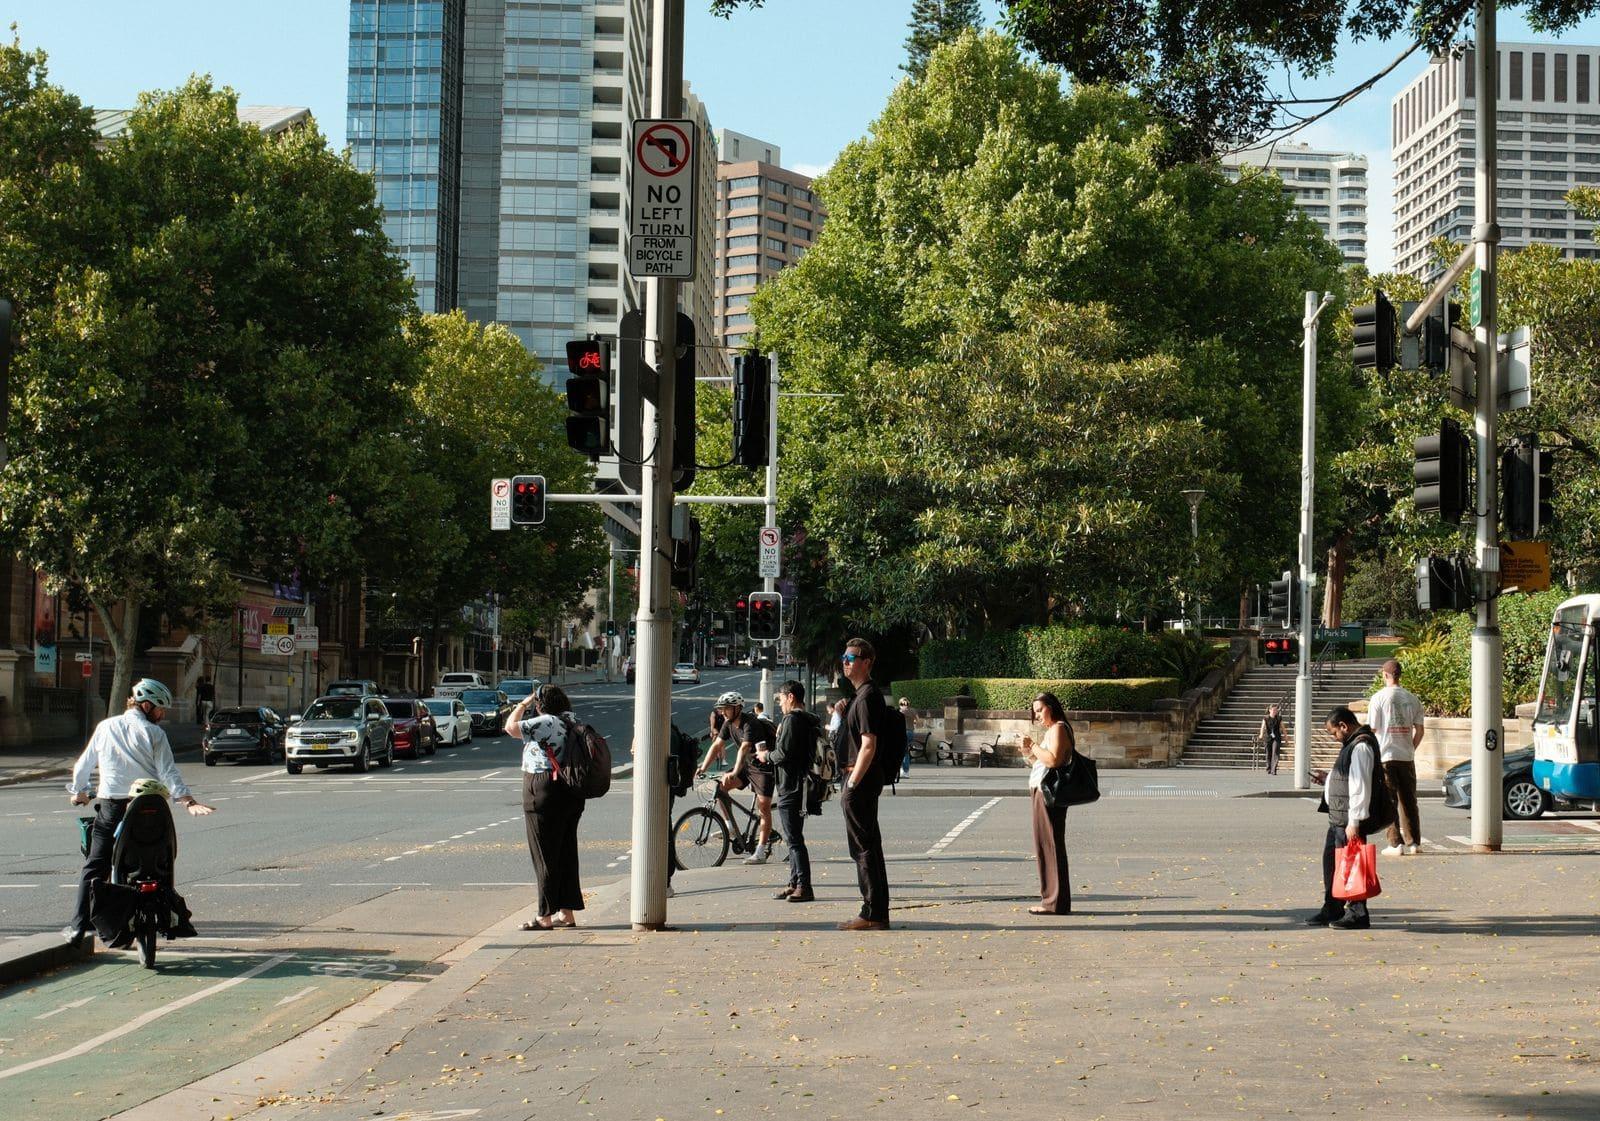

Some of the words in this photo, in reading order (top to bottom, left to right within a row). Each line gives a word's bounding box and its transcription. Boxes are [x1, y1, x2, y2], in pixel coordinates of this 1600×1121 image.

[647, 185, 681, 204] NO
[641, 207, 683, 220] LEFT
[639, 223, 685, 235] TURN
[643, 238, 676, 249] FROM
[636, 250, 683, 261] BICYCLE
[645, 262, 673, 274] PATH
[1324, 629, 1340, 637] Park
[1340, 629, 1348, 637] St
[280, 641, 291, 649] 40
